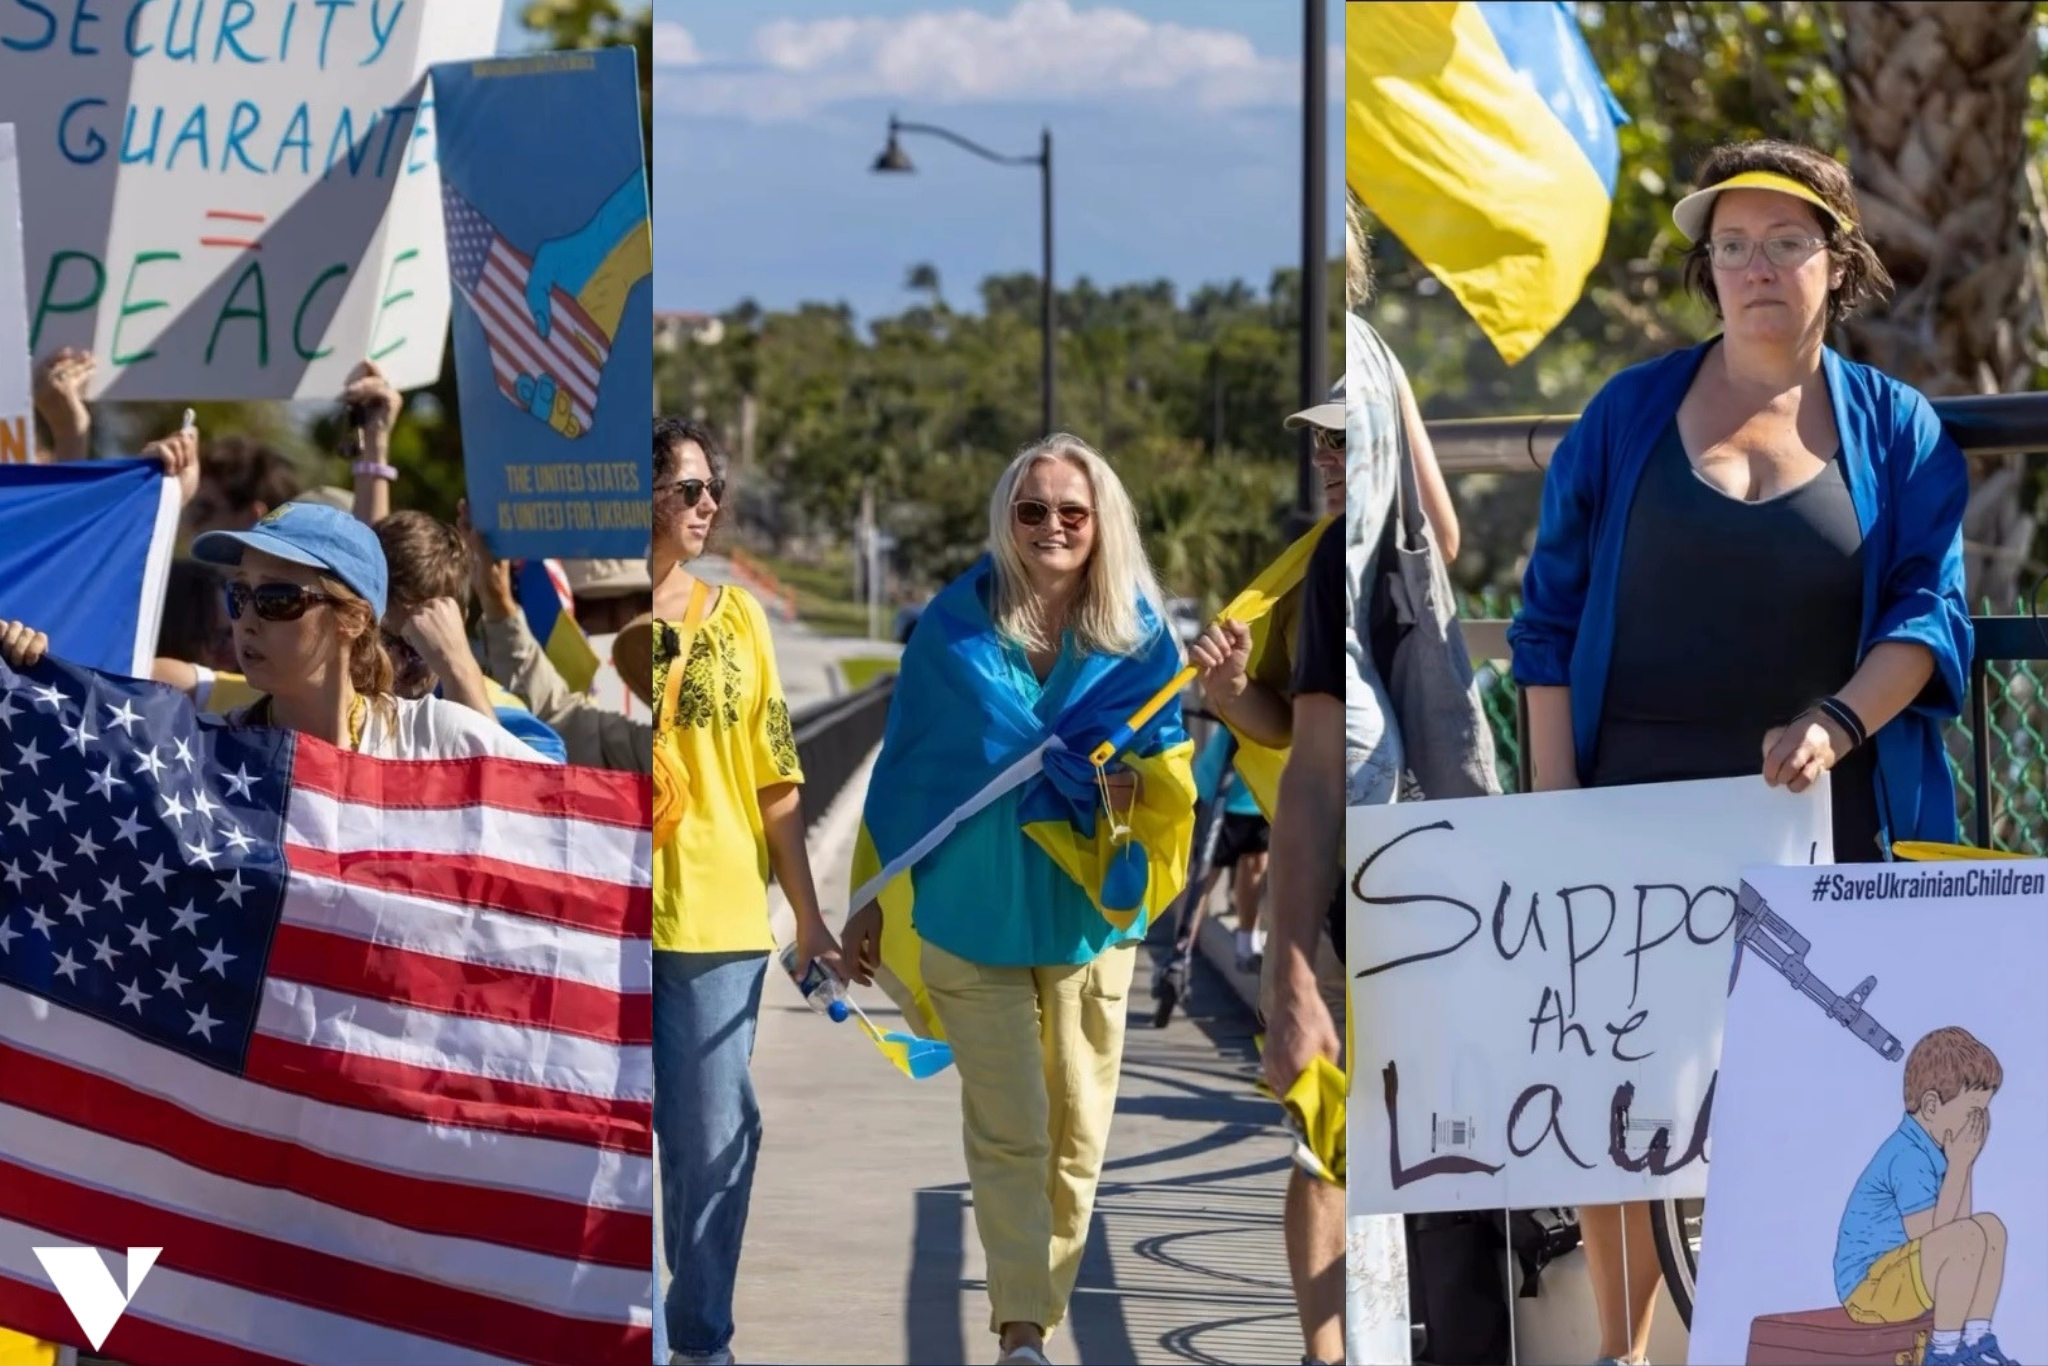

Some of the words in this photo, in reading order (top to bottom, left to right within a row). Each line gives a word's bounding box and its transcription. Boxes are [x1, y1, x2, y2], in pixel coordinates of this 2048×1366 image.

[0, 0, 402, 70] SECURITY
[57, 97, 439, 180] GUARANTE
[29, 249, 420, 368] PEACE
[505, 464, 533, 493] THE
[534, 462, 585, 492] UNITED
[586, 461, 640, 491] STATES
[513, 501, 563, 531] UNITED
[565, 500, 594, 531] FOR
[1351, 820, 1818, 1018] Suppo
[1812, 867, 2045, 902] #SaveUkrainianChildren
[1529, 986, 1657, 1061] the
